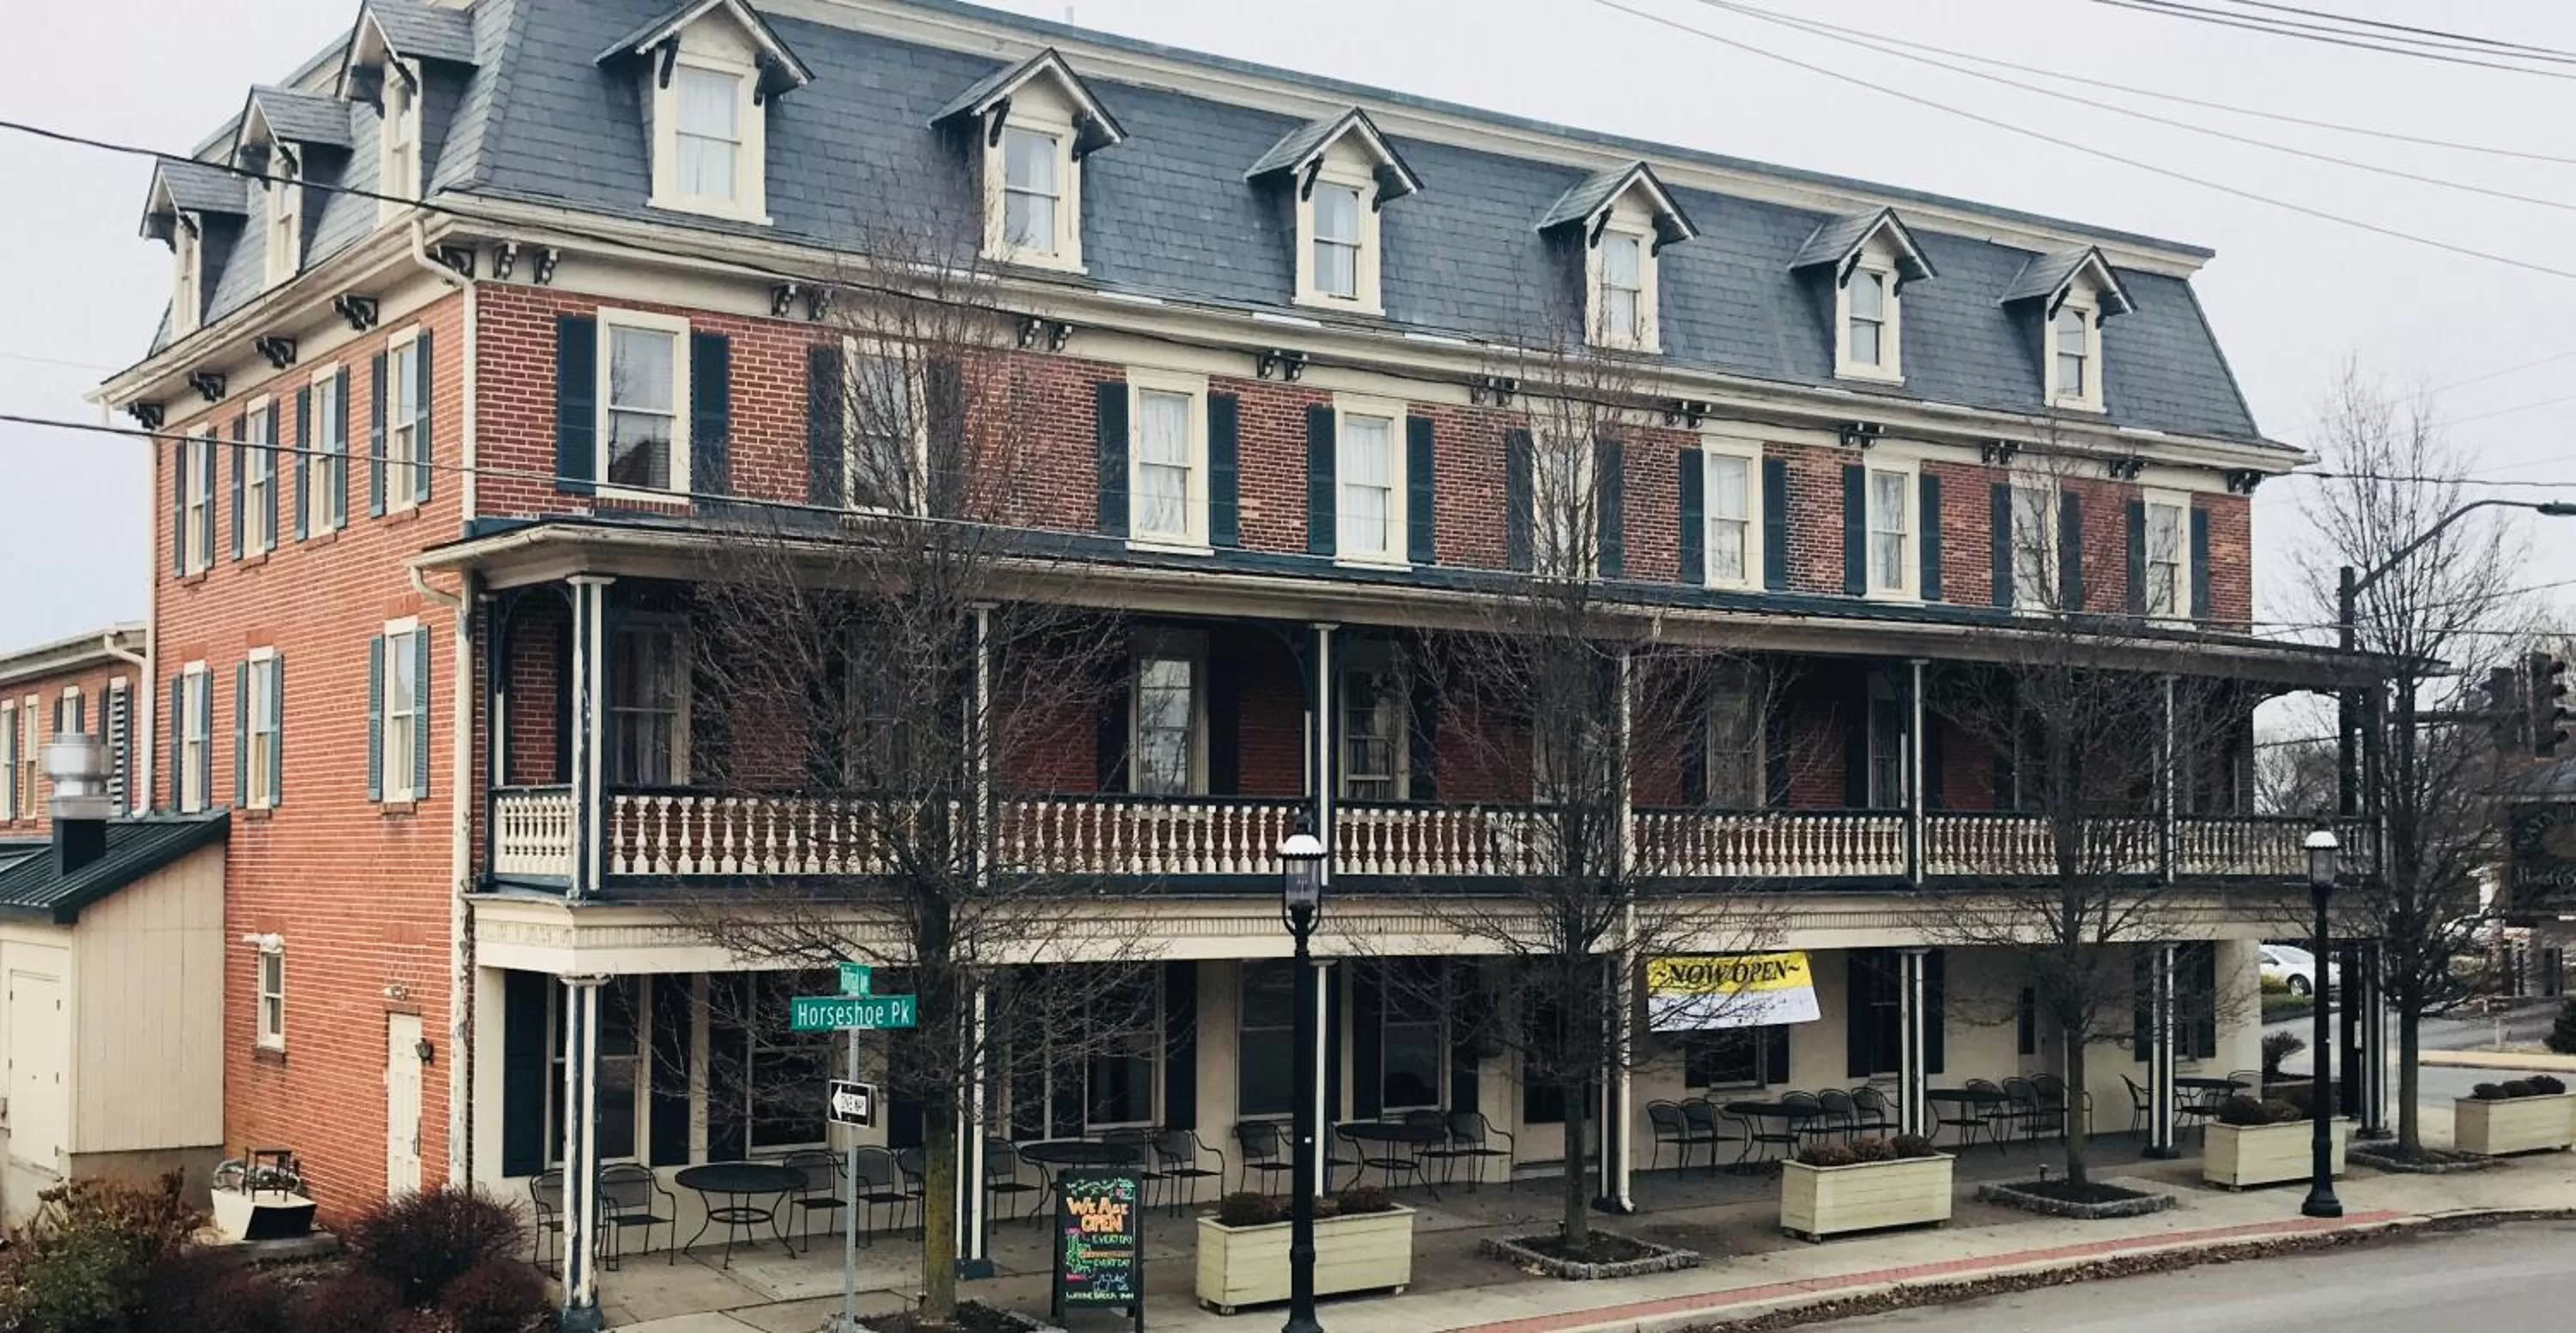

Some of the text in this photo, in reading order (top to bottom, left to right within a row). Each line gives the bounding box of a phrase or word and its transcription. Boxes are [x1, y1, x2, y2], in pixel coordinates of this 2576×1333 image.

[799, 1000, 909, 1026] Horseshoe Pk
[1081, 1214, 1123, 1233] OPEN
